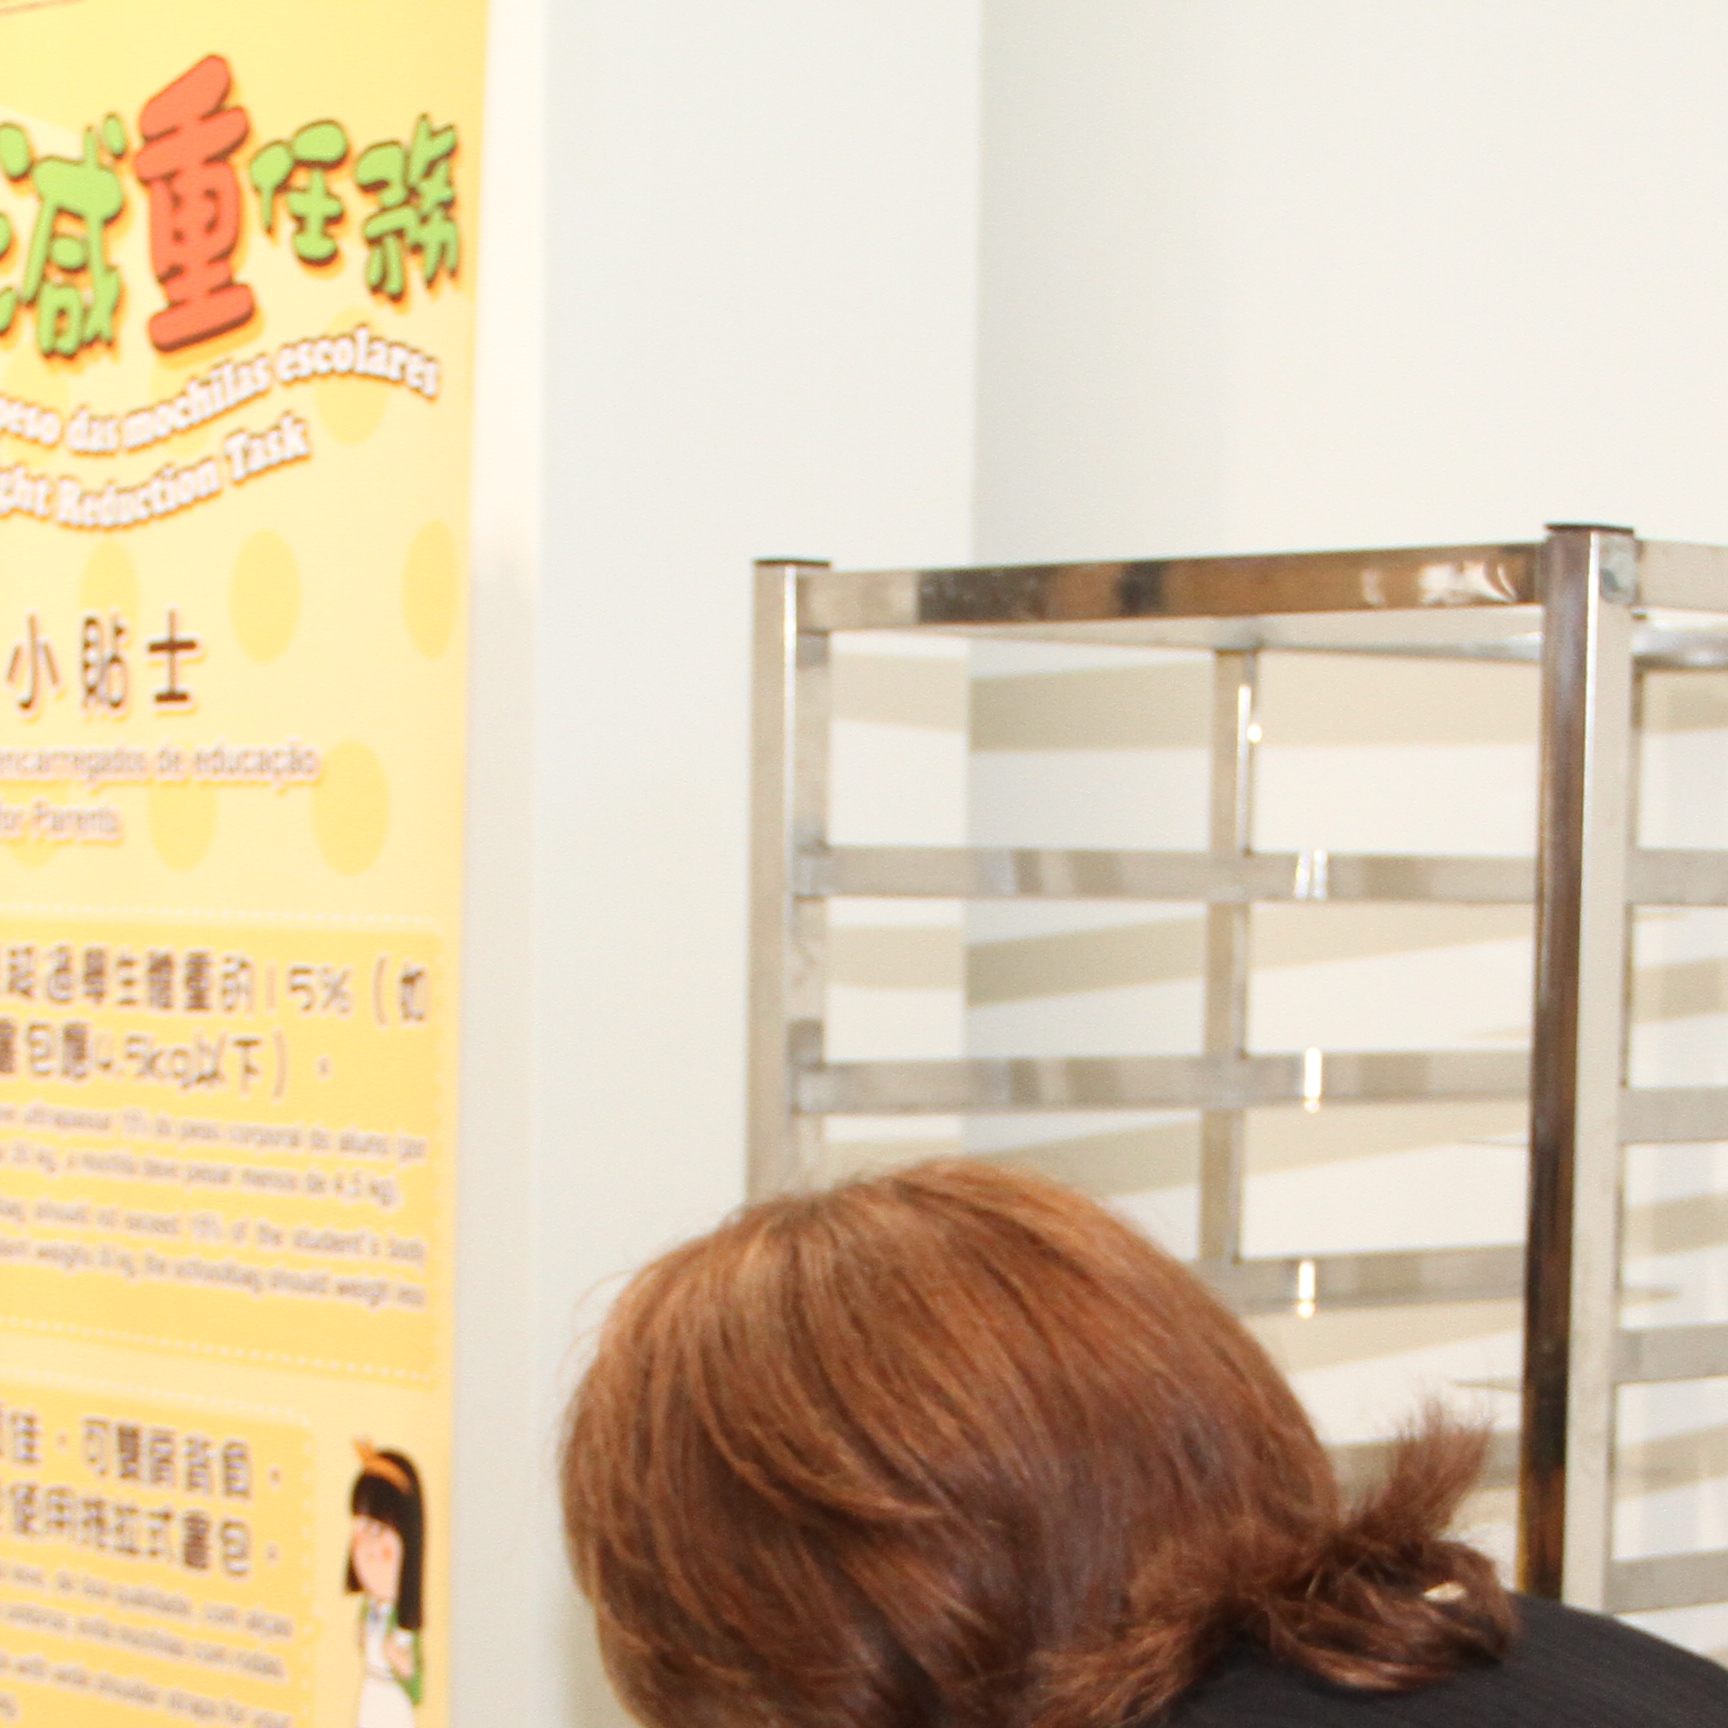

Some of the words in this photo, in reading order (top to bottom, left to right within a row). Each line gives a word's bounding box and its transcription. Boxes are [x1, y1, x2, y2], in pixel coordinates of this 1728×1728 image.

[70, 405, 119, 455] das
[124, 357, 270, 452] mochilas
[275, 322, 440, 402] escolares
[56, 460, 223, 532] Reduction
[224, 410, 310, 484] Task
[158, 742, 185, 776] de
[192, 740, 319, 787] educação
